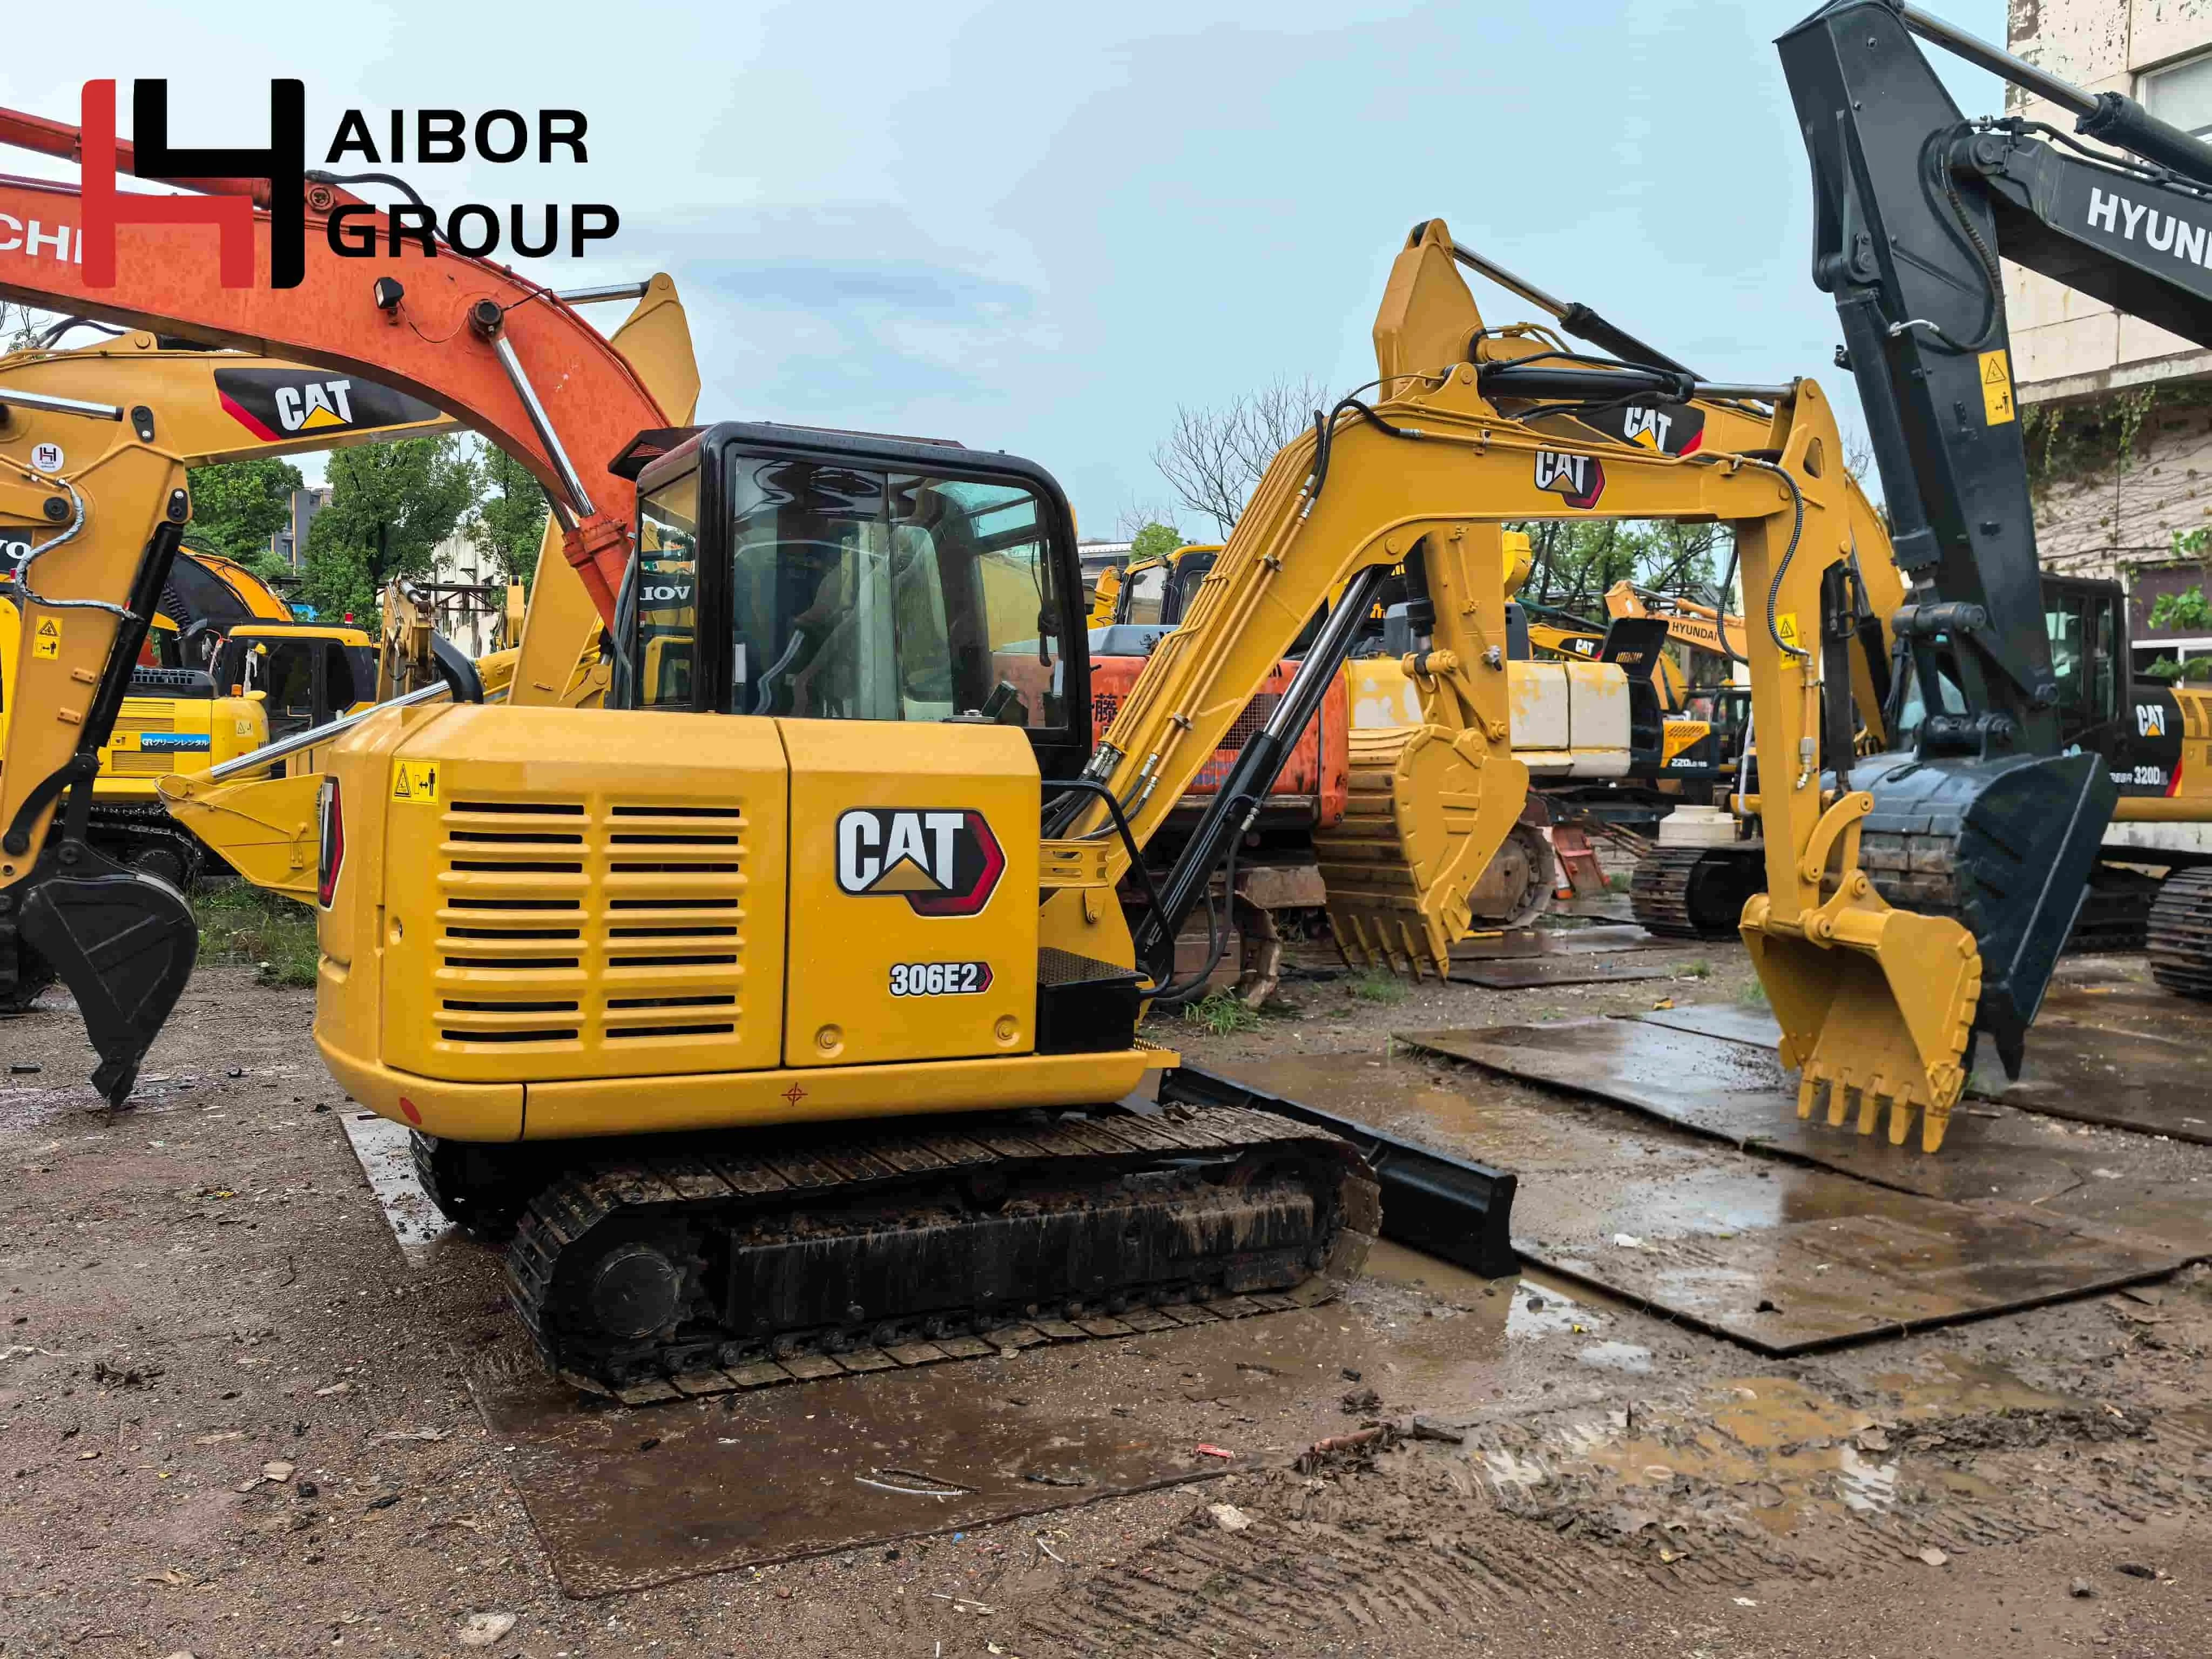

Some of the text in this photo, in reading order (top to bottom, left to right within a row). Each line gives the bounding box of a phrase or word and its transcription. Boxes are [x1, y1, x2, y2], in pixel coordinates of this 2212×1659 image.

[2087, 187, 2212, 270] HYUN
[275, 380, 352, 431] CAT
[1623, 407, 1673, 455] CAT
[1536, 445, 1589, 494] CAT
[1575, 639, 1594, 656] CAT
[1672, 622, 1718, 642] HYUNDAI
[2136, 704, 2165, 737] CAT
[2134, 766, 2160, 785] 320D
[839, 811, 964, 891] CAT
[891, 963, 979, 995] 306E2
